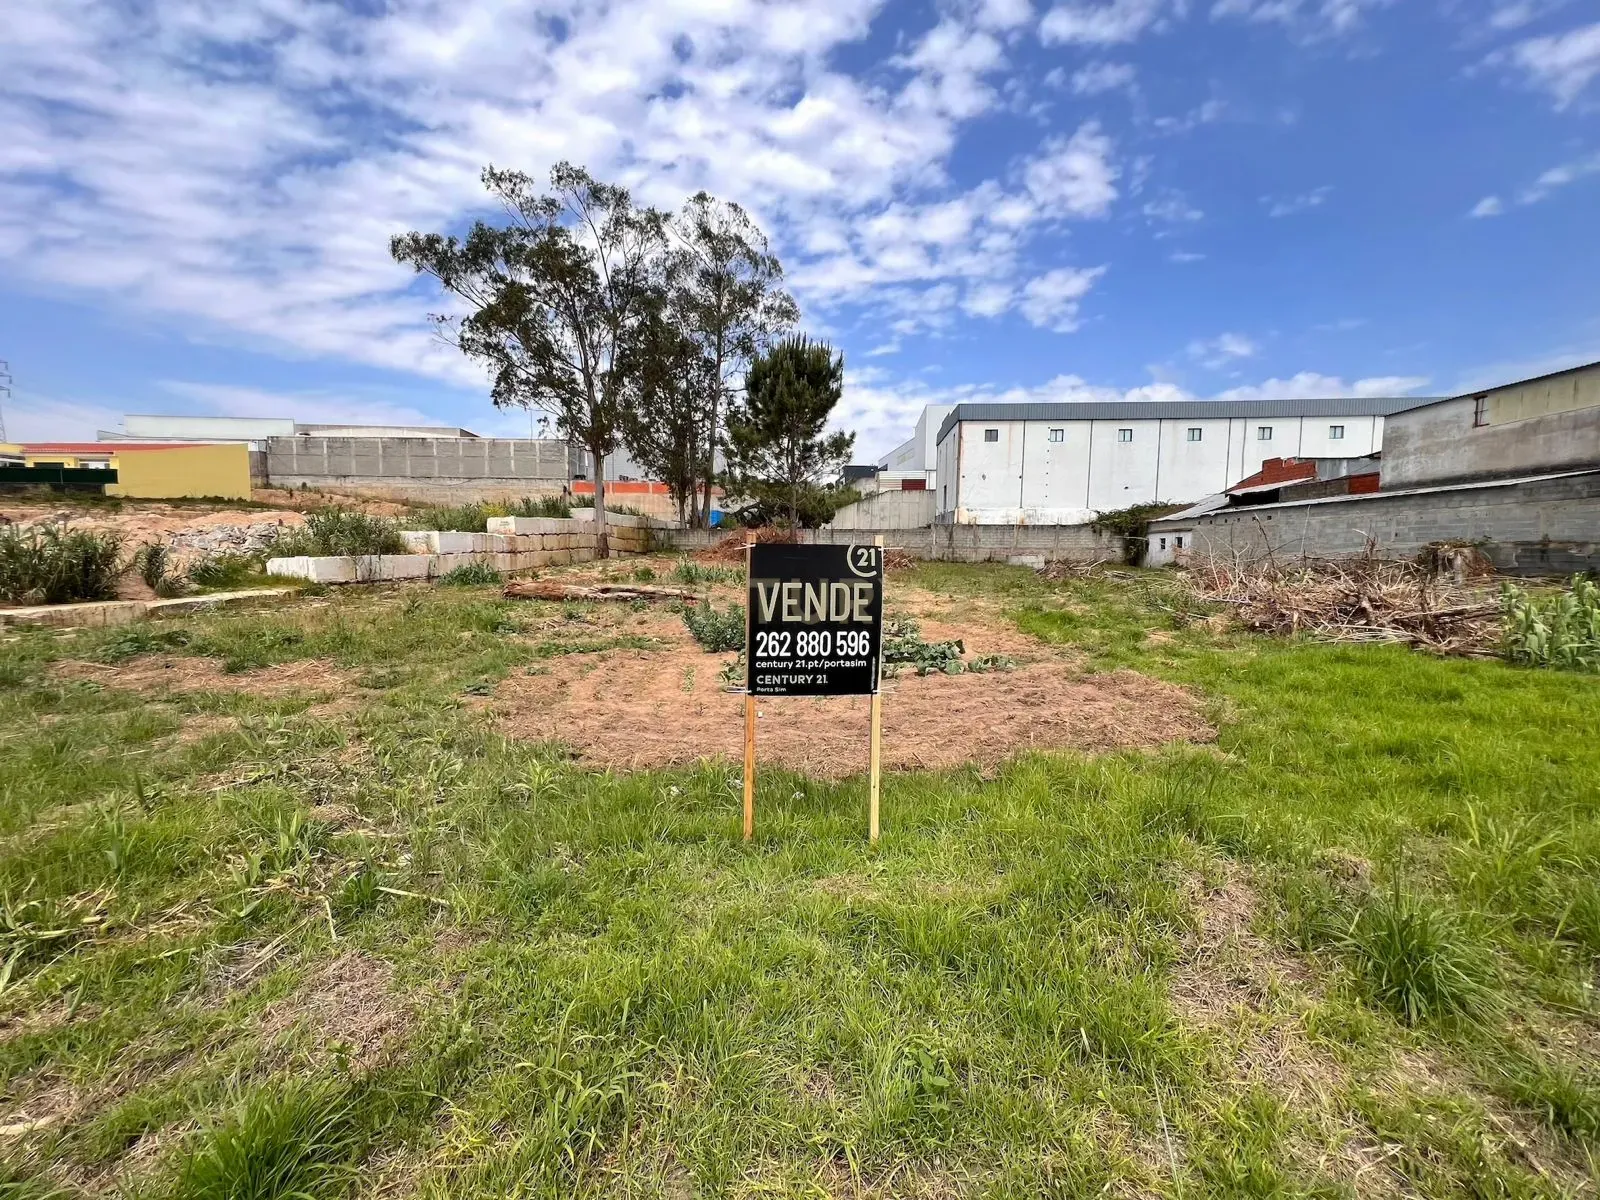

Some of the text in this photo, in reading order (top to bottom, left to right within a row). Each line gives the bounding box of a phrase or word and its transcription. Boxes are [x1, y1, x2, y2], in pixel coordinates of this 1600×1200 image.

[757, 582, 874, 622] VENDE
[755, 630, 870, 657] 262 880 596
[755, 659, 867, 670] century 21.pt/portasim
[756, 675, 814, 685] CENTURY
